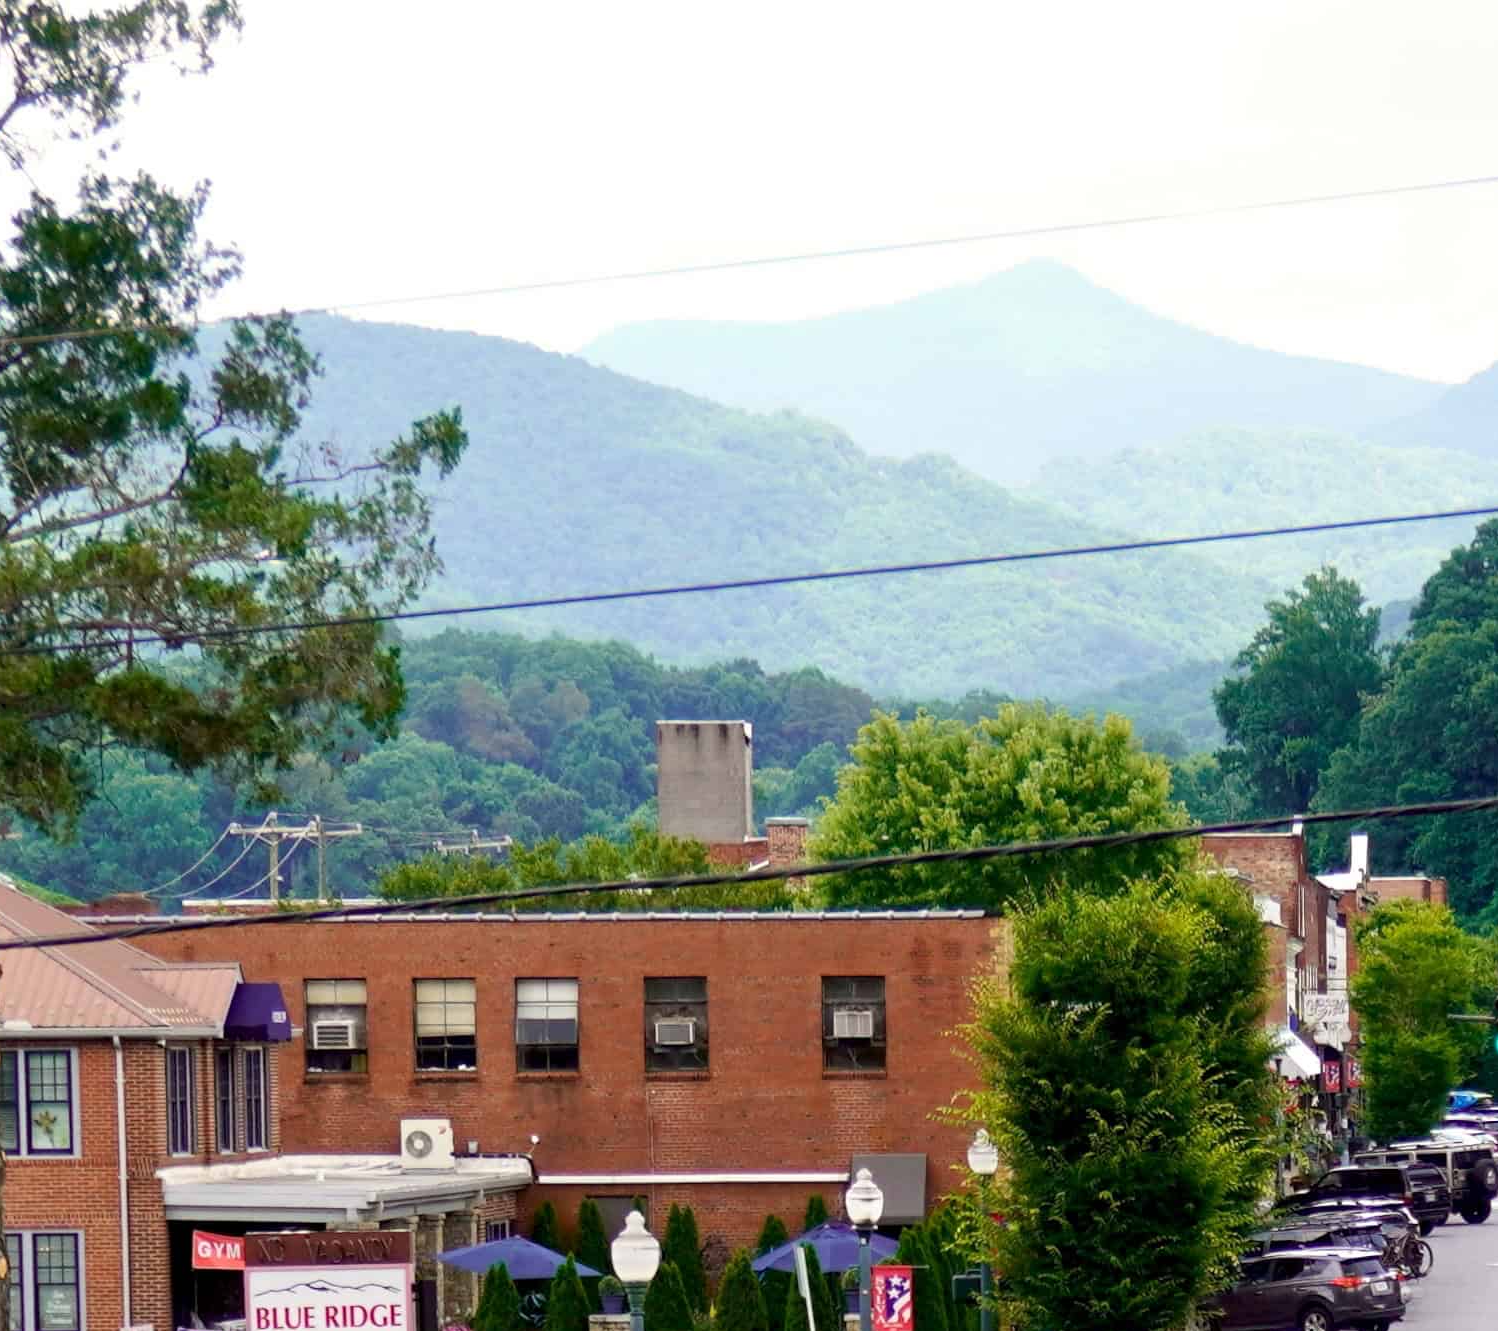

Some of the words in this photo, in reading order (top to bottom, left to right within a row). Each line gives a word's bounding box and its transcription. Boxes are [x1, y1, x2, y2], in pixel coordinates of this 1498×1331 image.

[196, 1240, 242, 1261] GYM
[255, 1305, 316, 1330] BLUE
[324, 1303, 402, 1329] RIDGE
